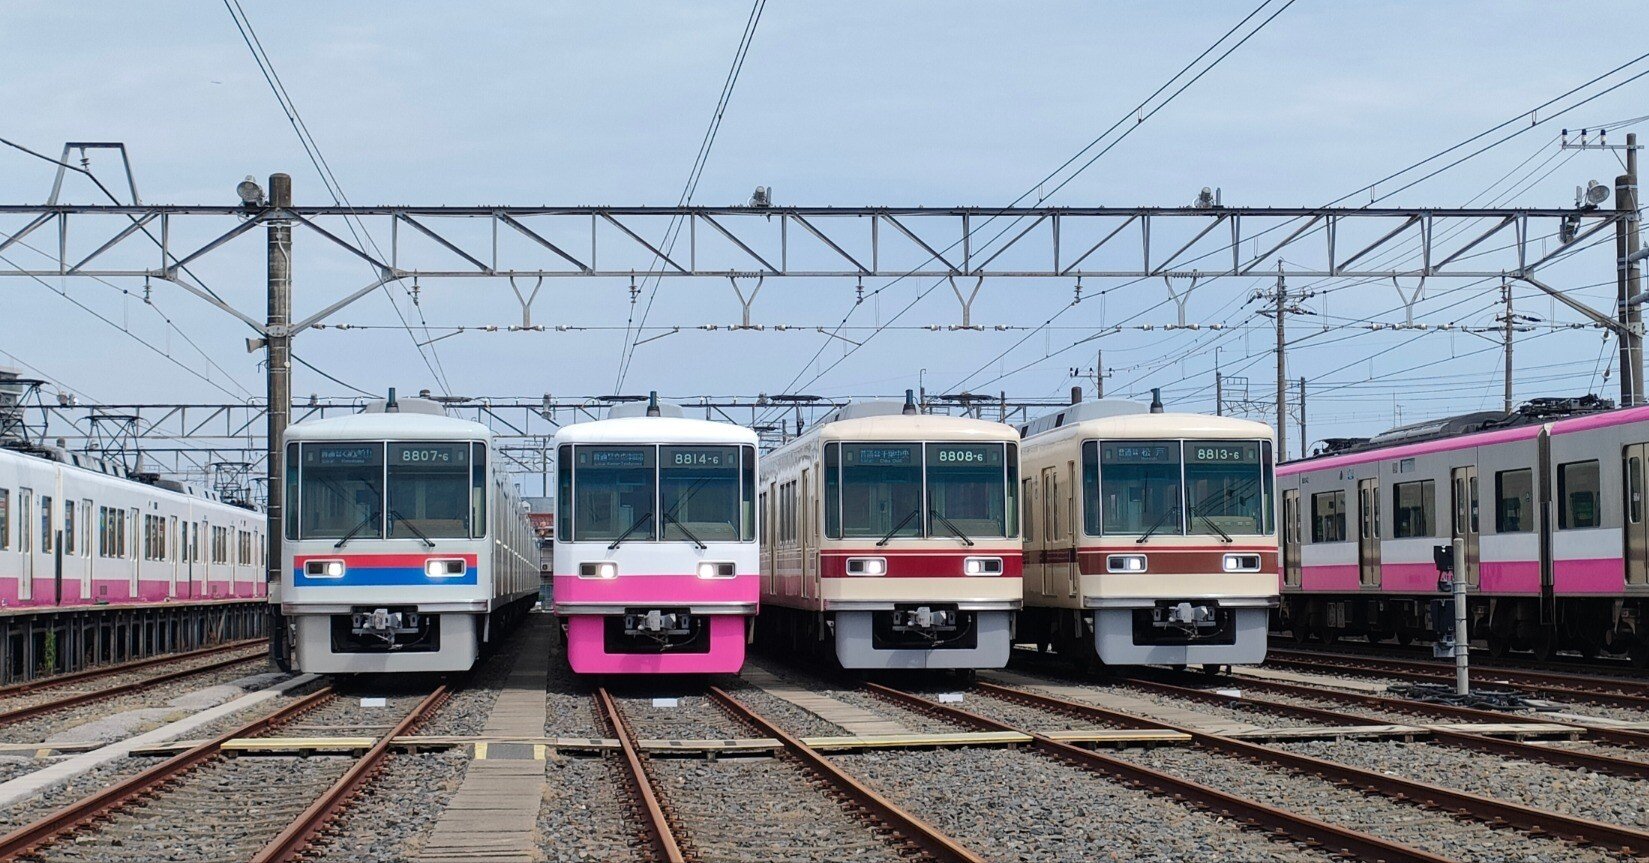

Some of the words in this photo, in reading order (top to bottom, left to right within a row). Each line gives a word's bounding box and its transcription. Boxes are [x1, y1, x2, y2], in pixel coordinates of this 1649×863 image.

[402, 450, 449, 461] 8807-6
[675, 453, 719, 464] 8814-6
[939, 450, 983, 461] 8808-6
[1198, 449, 1240, 459] 8813-6
